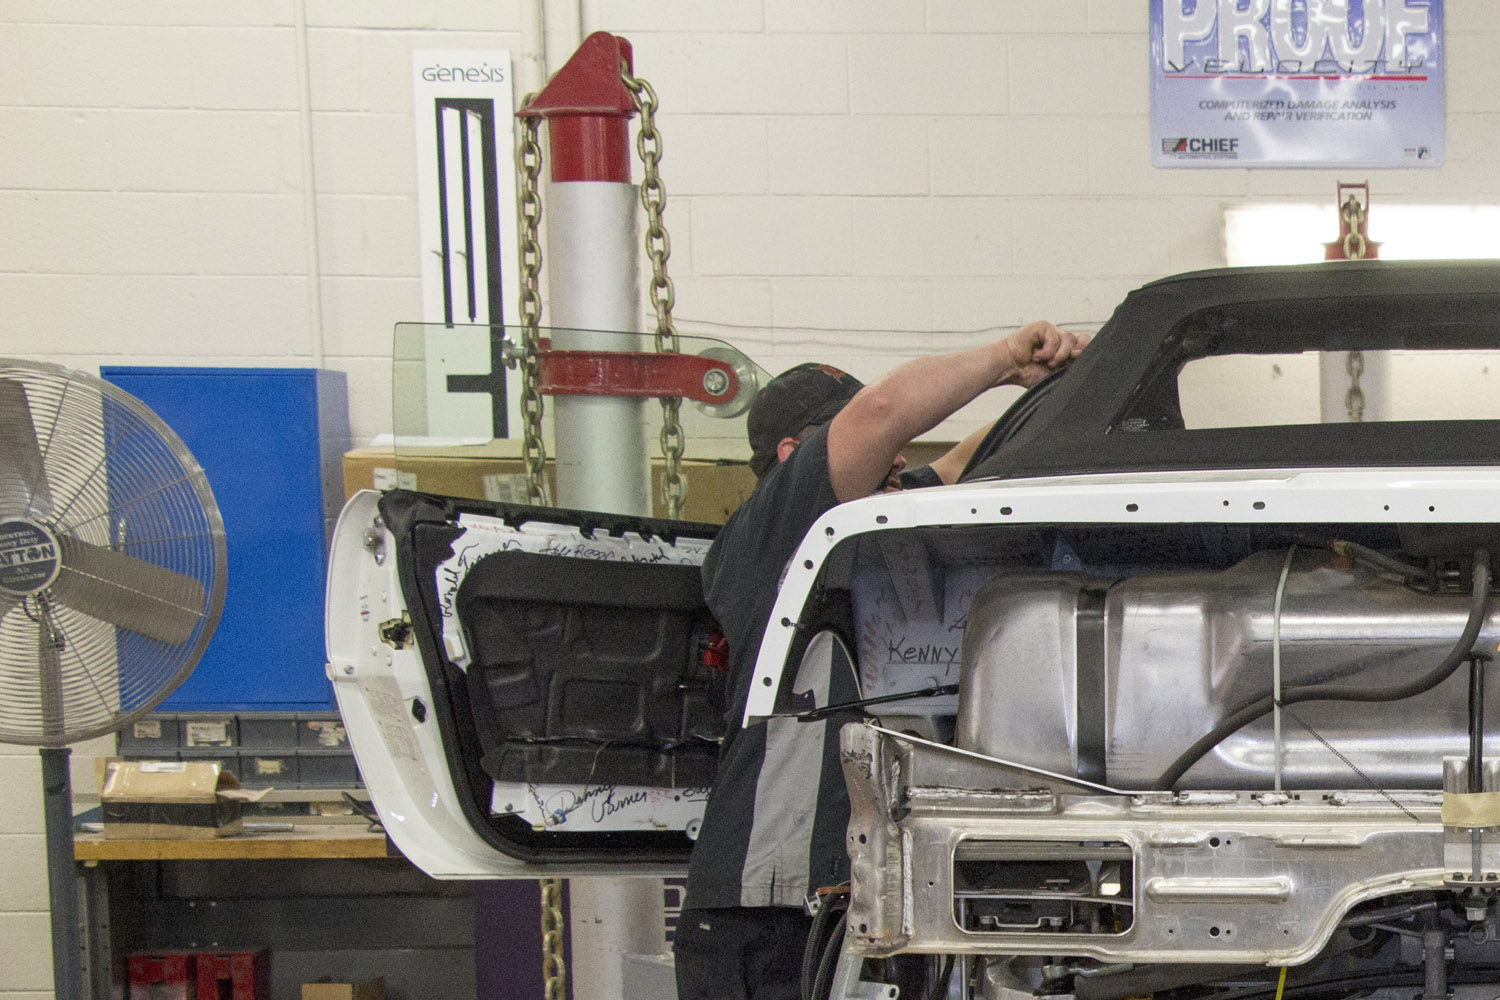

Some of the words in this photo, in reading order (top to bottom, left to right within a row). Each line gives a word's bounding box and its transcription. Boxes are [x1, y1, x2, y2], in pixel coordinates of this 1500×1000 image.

[1163, 0, 1429, 73] PROOF
[1198, 100, 1285, 110] COMPUTERIZED
[1287, 100, 1338, 110] DAMAGE
[1341, 100, 1397, 110] ANALYSIS
[1224, 111, 1250, 121] AND
[1253, 111, 1292, 121] REPAIR
[1295, 111, 1373, 121] VERIFICATION
[1189, 138, 1239, 152] CHIEF
